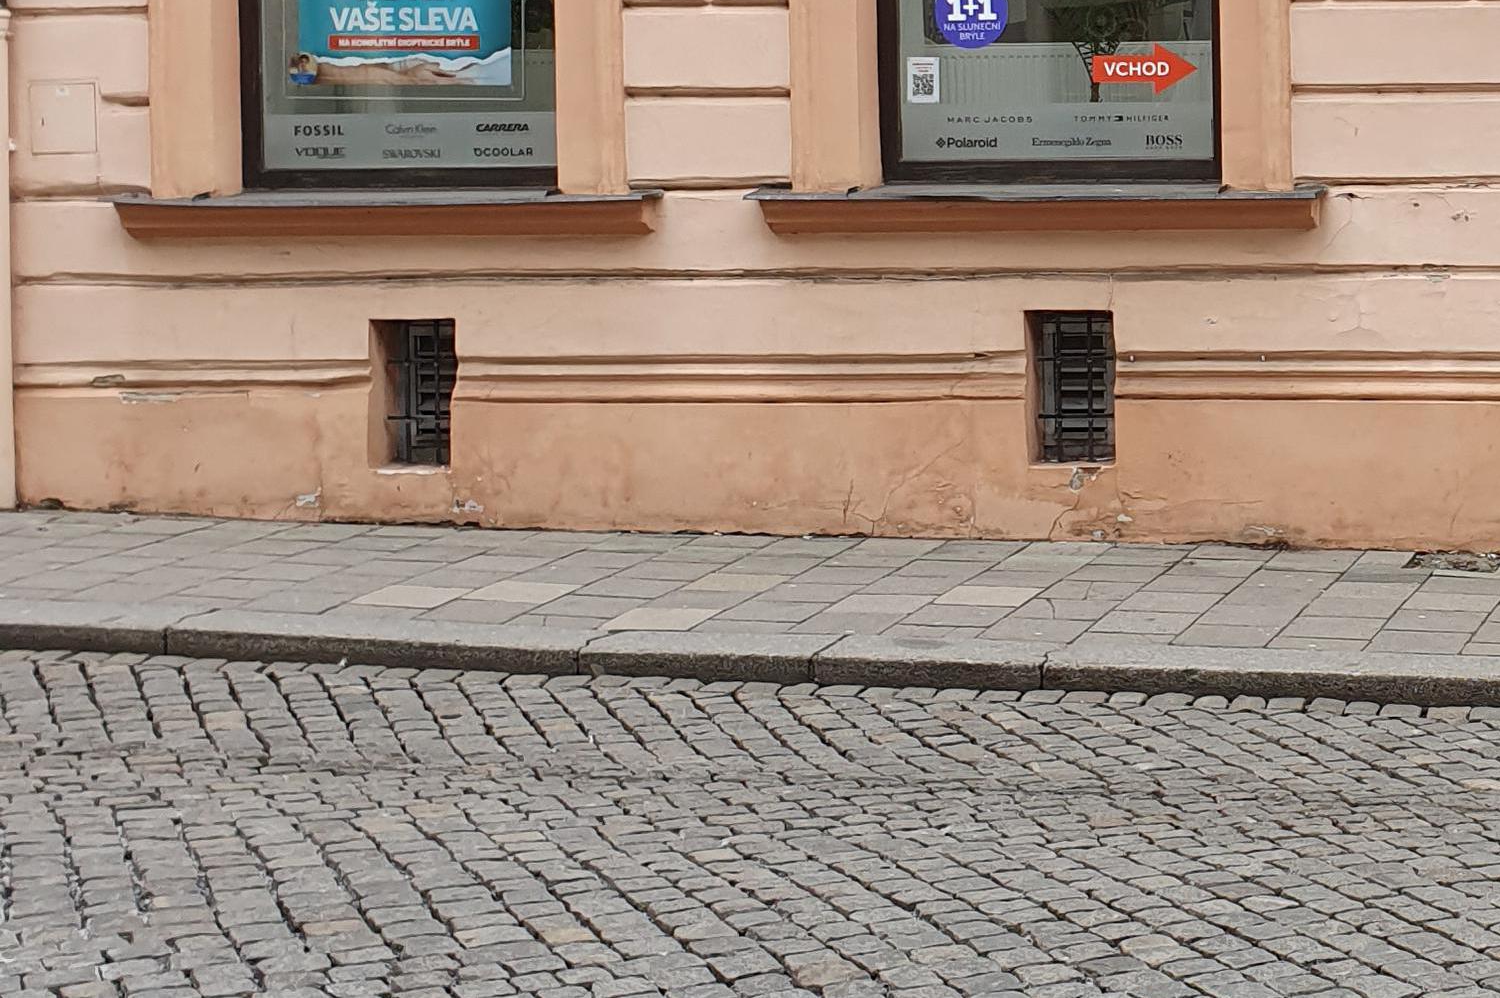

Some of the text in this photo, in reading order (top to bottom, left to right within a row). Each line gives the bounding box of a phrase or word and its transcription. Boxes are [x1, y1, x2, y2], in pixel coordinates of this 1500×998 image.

[329, 2, 478, 32] VAŠE SLEVA
[944, 23, 956, 31] NA
[1103, 61, 1170, 78] VCHOD
[1074, 114, 1169, 123] TOMMY HILFIGER
[294, 125, 344, 136] FOSSIL
[476, 123, 530, 132] CARRERA
[947, 137, 998, 148] Polaroid
[1145, 134, 1183, 146] BOSS
